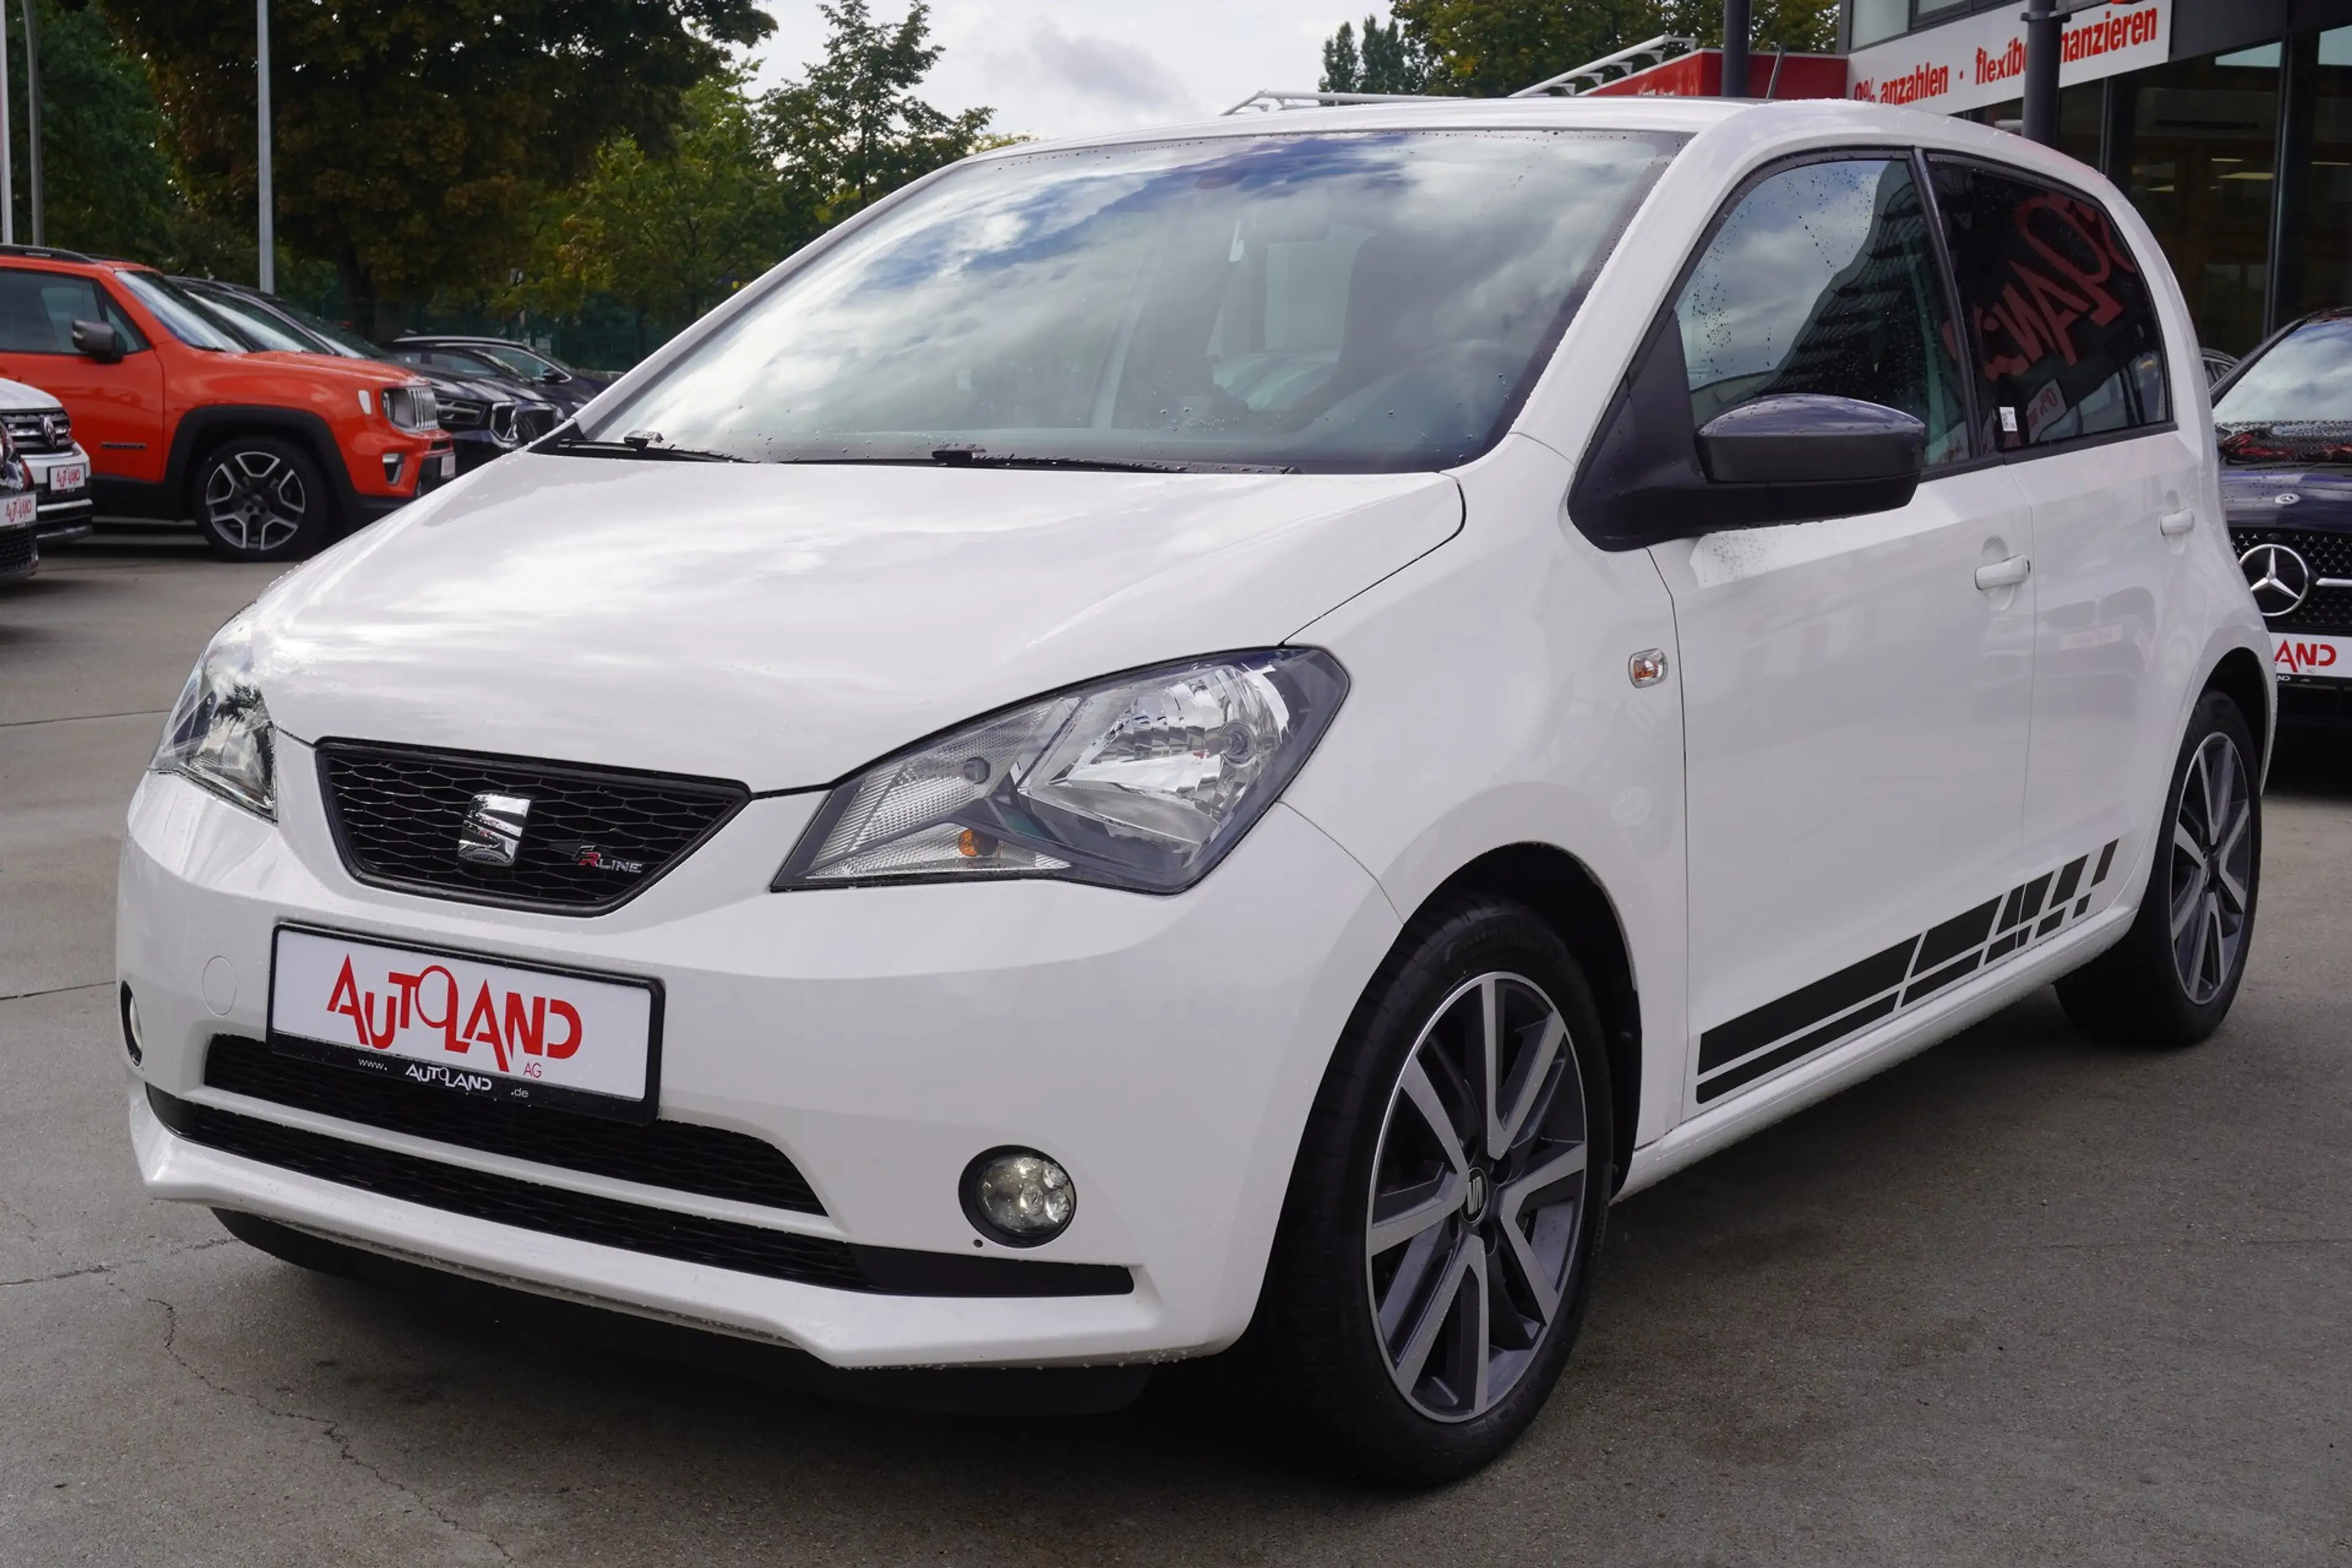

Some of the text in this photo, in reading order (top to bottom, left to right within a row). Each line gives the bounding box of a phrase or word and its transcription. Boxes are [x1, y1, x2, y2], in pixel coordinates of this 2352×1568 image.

[1880, 62, 1949, 105] anzahlen
[1975, 37, 2027, 85] flexib
[2060, 7, 2157, 63] nanzieren
[2273, 639, 2337, 673] AND
[327, 954, 582, 1072] AUTOLAND
[358, 1058, 529, 1099] www. AUTOLAND .de
[524, 1062, 541, 1079] AG
